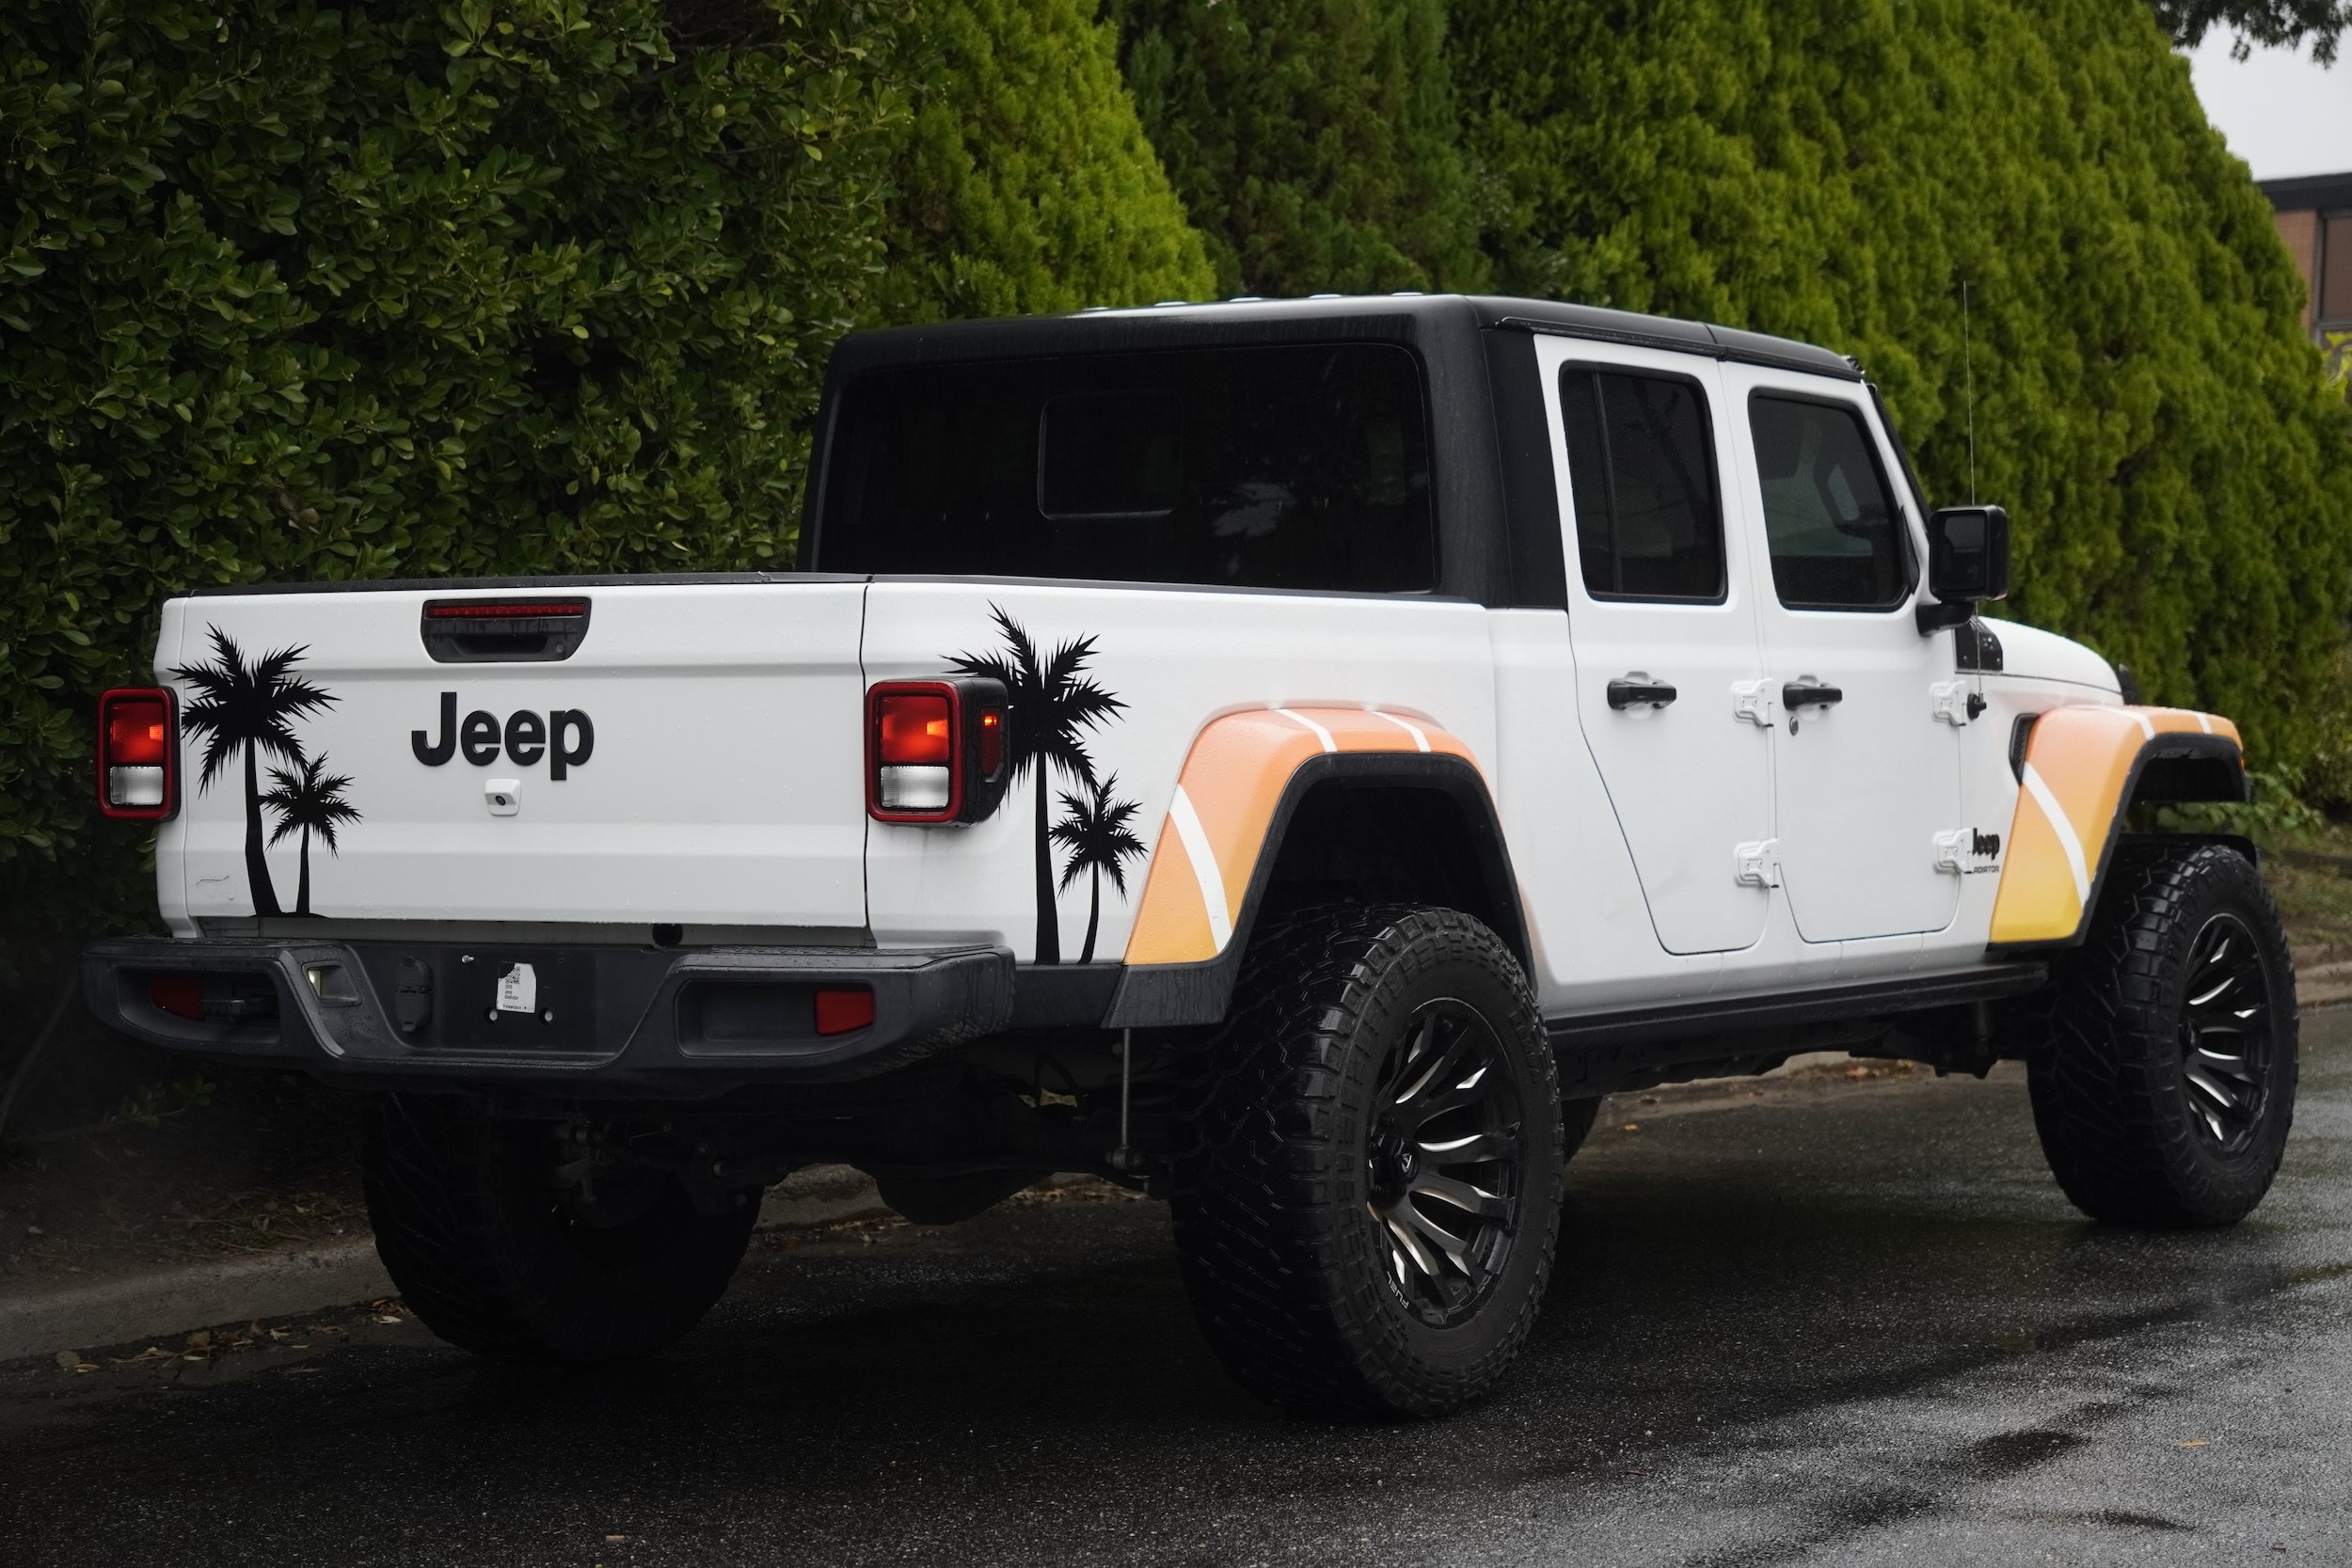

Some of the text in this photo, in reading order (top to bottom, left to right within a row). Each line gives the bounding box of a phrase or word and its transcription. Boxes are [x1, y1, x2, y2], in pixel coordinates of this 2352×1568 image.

[411, 691, 595, 781] Jeep
[1972, 864, 2000, 874] ADIATOR
[1386, 1270, 1410, 1309] FUEL
